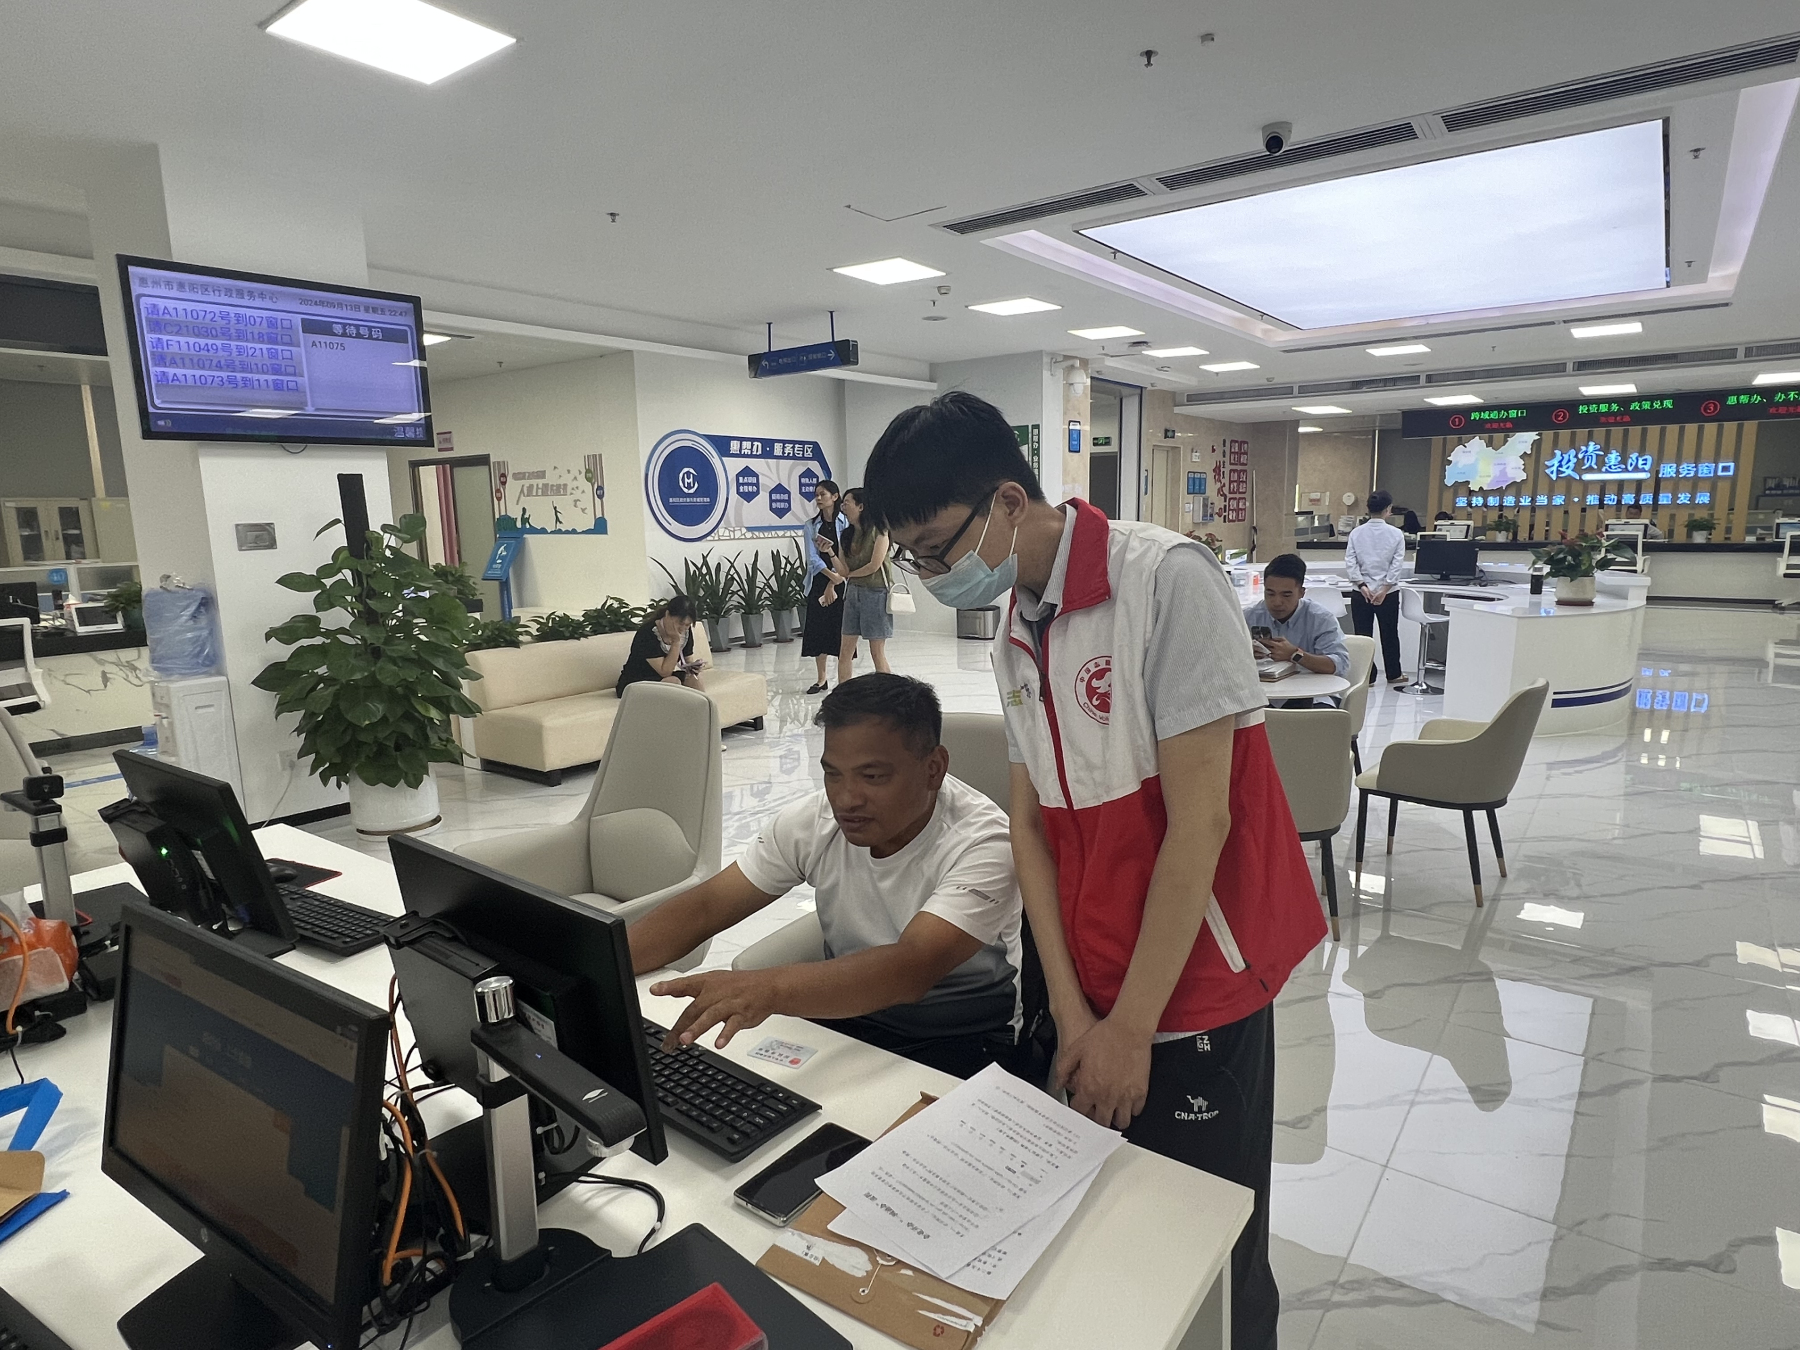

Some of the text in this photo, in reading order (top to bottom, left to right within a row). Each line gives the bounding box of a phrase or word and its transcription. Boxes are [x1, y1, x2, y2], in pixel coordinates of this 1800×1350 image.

[144, 302, 293, 330] 请A11072号到07窗口
[332, 323, 383, 340] 等待号码
[149, 336, 293, 361] 请F11049号到21窗口
[311, 340, 346, 351] A11075
[154, 370, 299, 392] 请A11073号到11窗口
[1578, 399, 1674, 414] 投资服务、政策兑现
[1544, 441, 1653, 480] 投资惠阳
[1658, 462, 1735, 478] 服务窗口
